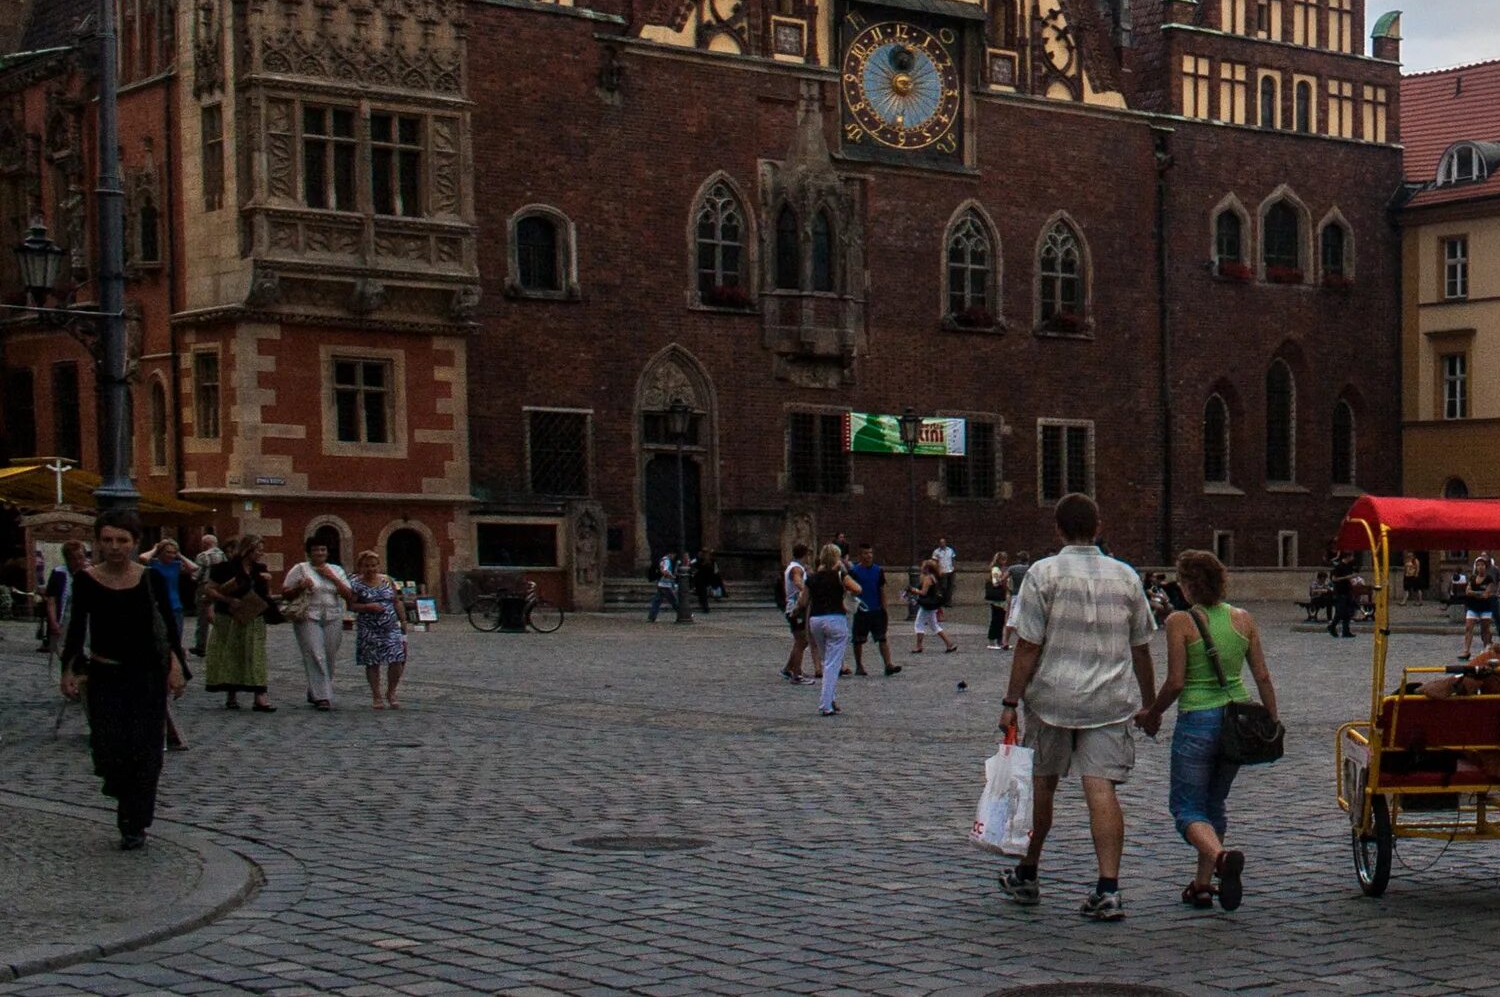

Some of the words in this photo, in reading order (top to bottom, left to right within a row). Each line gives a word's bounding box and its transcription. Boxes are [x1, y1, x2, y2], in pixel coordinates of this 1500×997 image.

[870, 27, 883, 42] 11
[896, 24, 909, 39] 12
[922, 36, 932, 48] 1
[851, 43, 868, 58] 10
[844, 73, 859, 84] 9
[851, 102, 865, 112] 8
[897, 131, 906, 146] 6
[922, 129, 932, 143] 5
